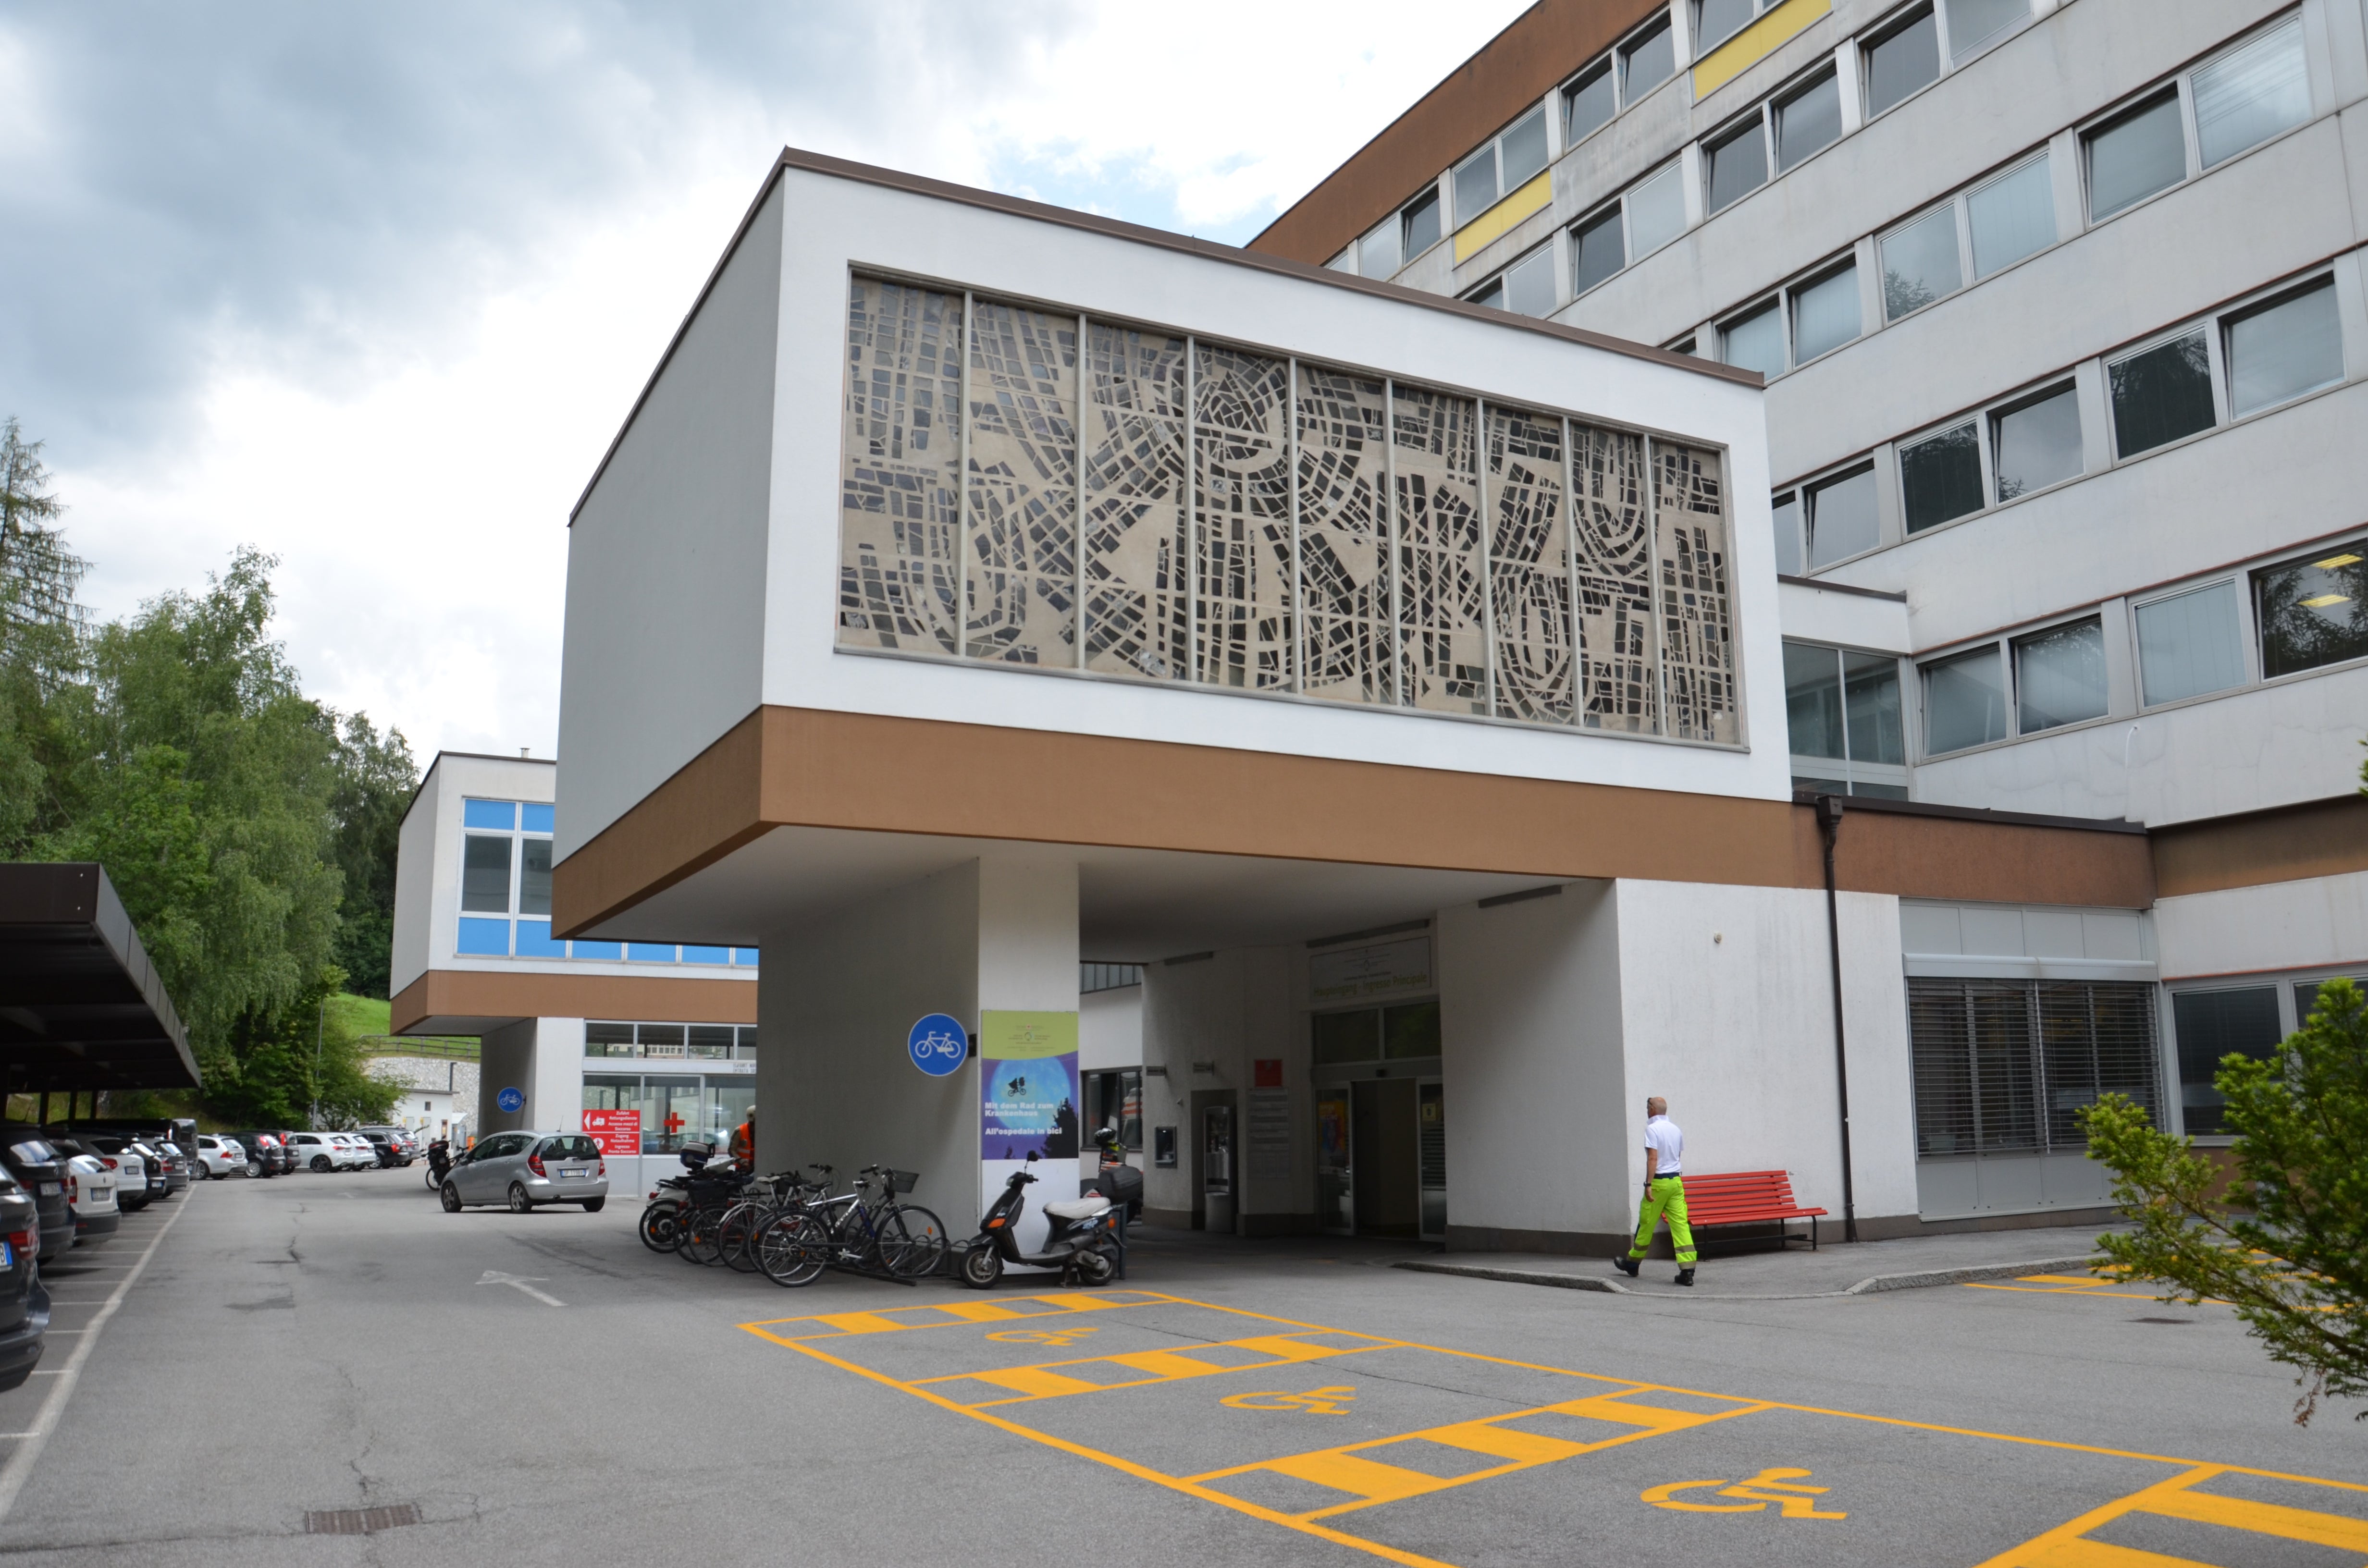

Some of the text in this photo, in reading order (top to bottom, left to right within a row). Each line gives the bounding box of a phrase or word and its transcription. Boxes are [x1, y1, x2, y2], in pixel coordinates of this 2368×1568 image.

[1314, 984, 1357, 998] Haupteingang
[1363, 980, 1391, 992] Ingresso
[1393, 973, 1427, 986] Principale
[985, 1127, 1035, 1136] All'ospedale
